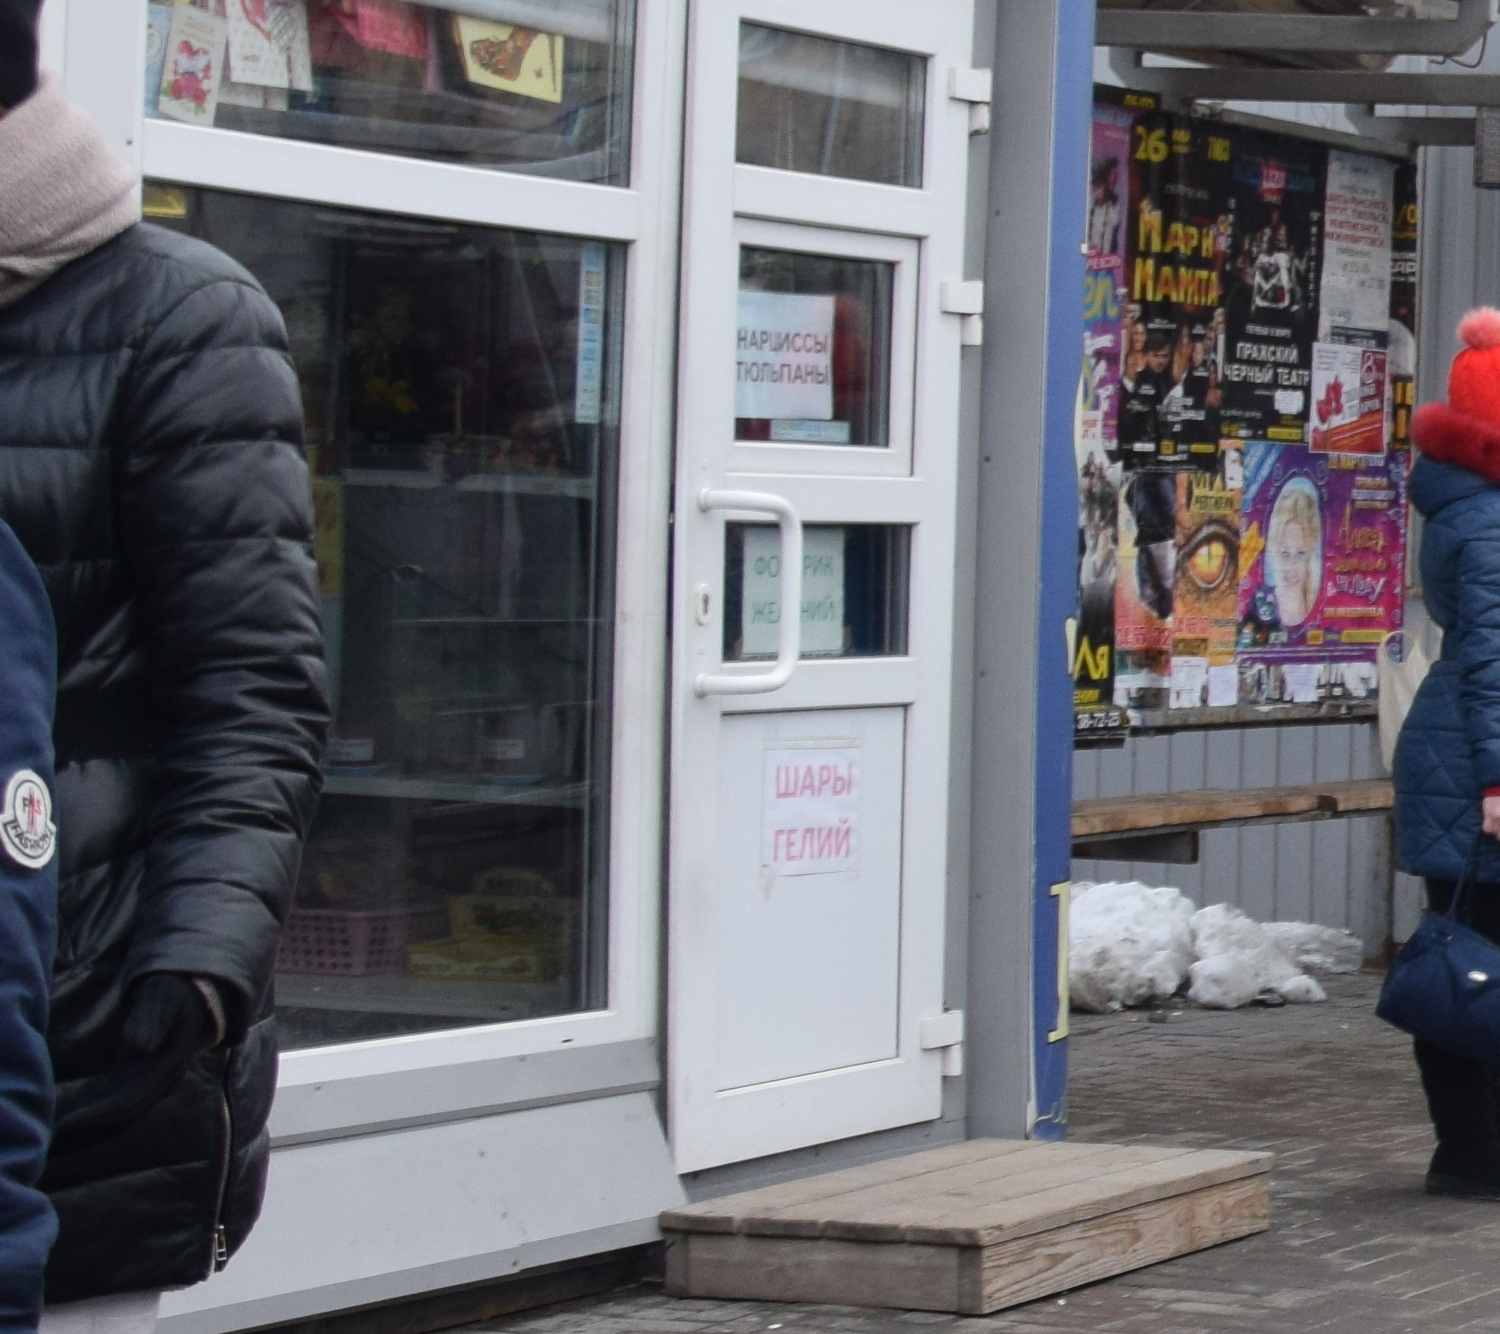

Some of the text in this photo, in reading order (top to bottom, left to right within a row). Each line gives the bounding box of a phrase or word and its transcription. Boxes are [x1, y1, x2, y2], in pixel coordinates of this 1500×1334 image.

[737, 328, 829, 354] НАРЦИССЫ
[1235, 341, 1300, 365] ПРАЖСКИЙ
[736, 360, 830, 385] ТЮЛЬПАНЫ
[1224, 363, 1311, 386] ЧЕРНЫЙ ТЕАТР
[754, 555, 834, 581] ФОРИК
[775, 764, 854, 799] ШАРЫ
[773, 817, 853, 863] ГЕЛИЙ
